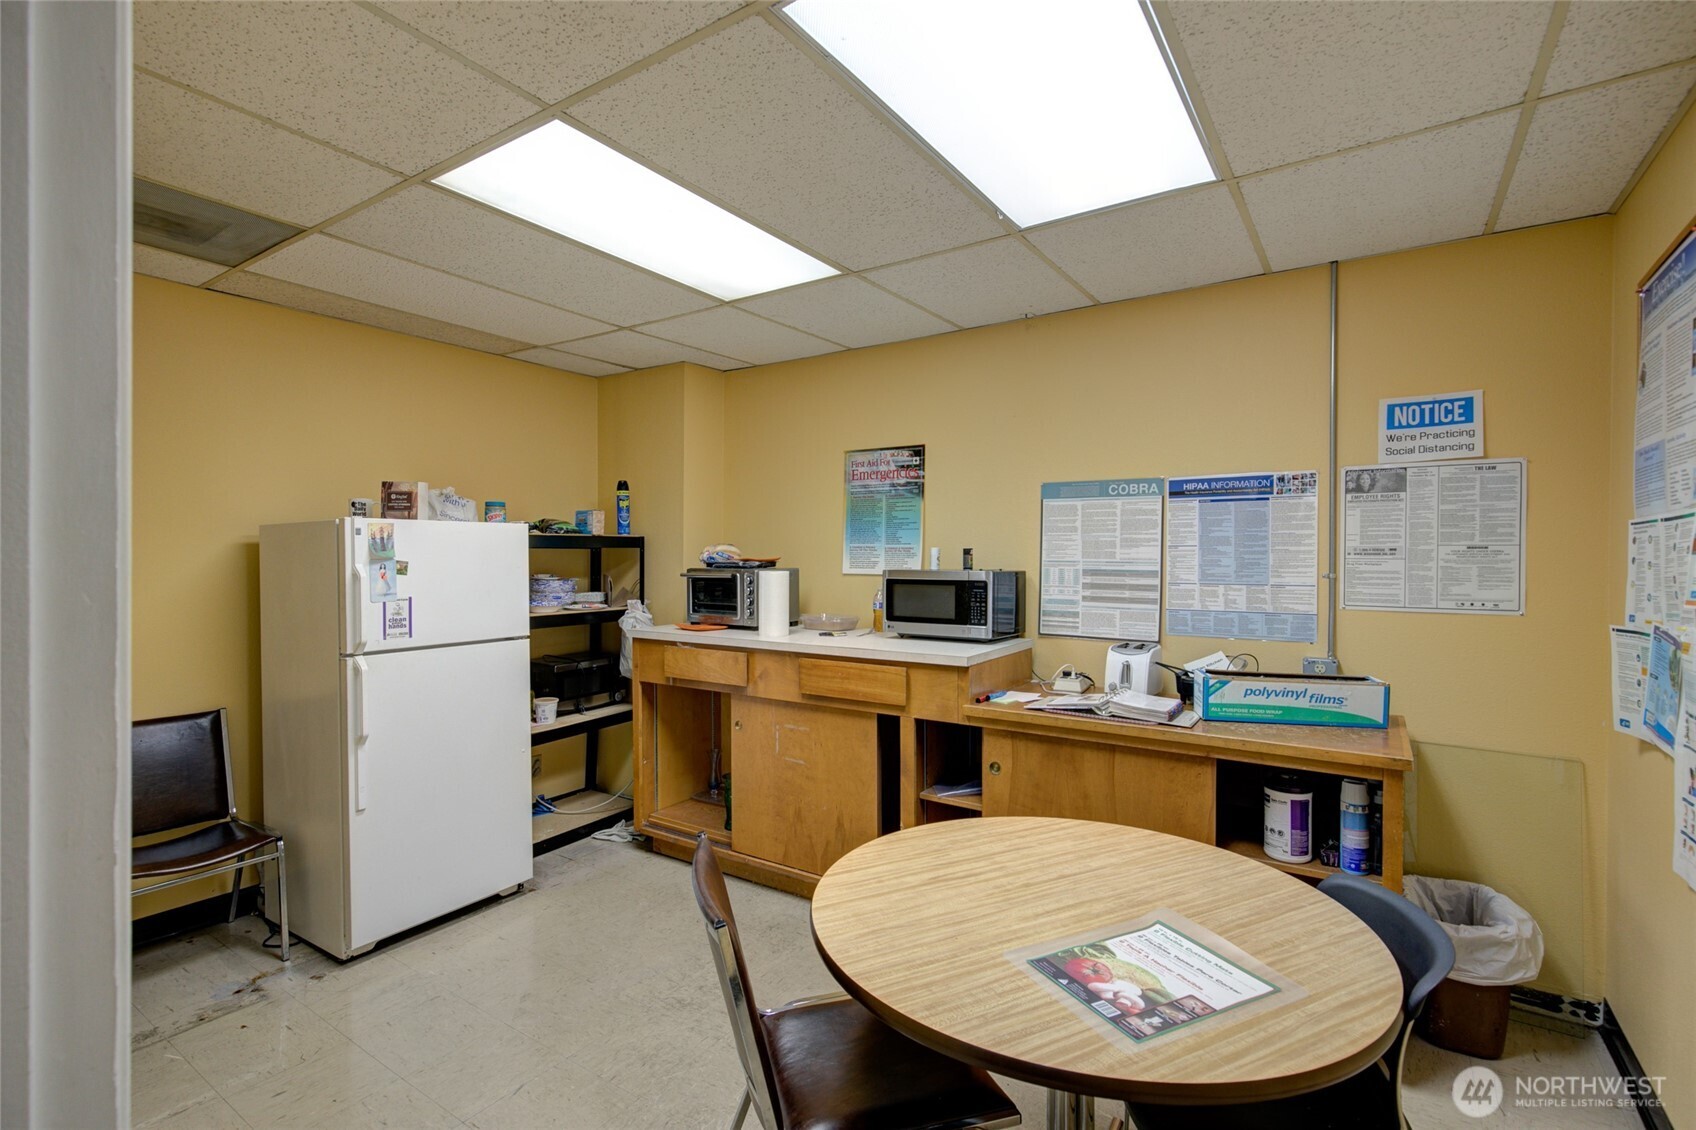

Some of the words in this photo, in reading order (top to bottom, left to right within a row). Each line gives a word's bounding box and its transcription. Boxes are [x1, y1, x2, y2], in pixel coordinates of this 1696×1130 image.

[1394, 400, 1466, 427] NOTICE
[1386, 431, 1416, 443] We're
[1419, 428, 1476, 442] Practicing
[1385, 445, 1416, 456] Social
[1418, 442, 1475, 455] Distancing
[851, 460, 865, 468] First
[866, 459, 879, 467] Aid
[880, 458, 891, 467] For
[851, 464, 919, 482] Emergencies
[1108, 483, 1159, 495] COBRA
[1183, 482, 1209, 490] HIPAA
[1211, 479, 1270, 489] INFORMATION
[1244, 687, 1308, 701] polyvinyl
[1309, 693, 1344, 705] films
[1185, 947, 1212, 964] Cutting
